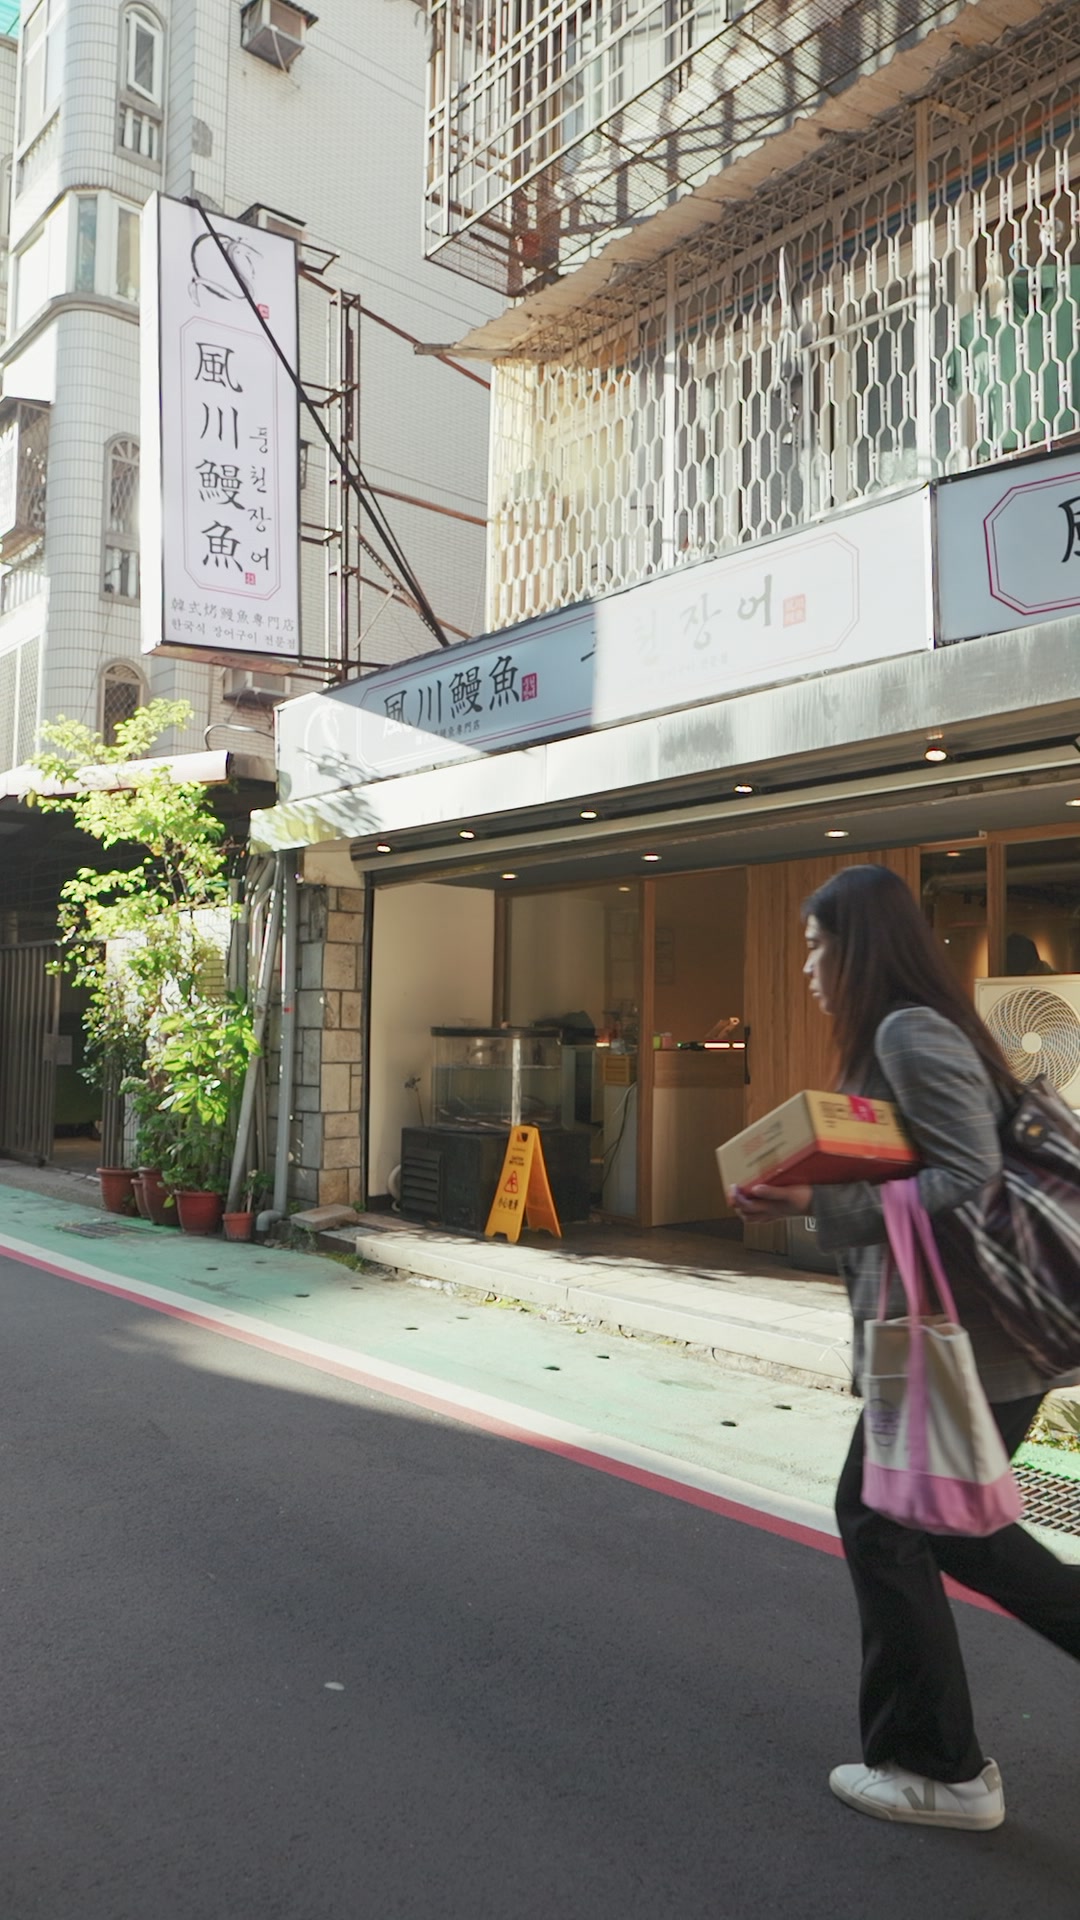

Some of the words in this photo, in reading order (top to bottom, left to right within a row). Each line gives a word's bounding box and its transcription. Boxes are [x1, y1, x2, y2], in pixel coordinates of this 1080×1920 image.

[195, 342, 245, 573] 風川鰻魚
[171, 598, 295, 632] 韓式烤鰻魚專門店
